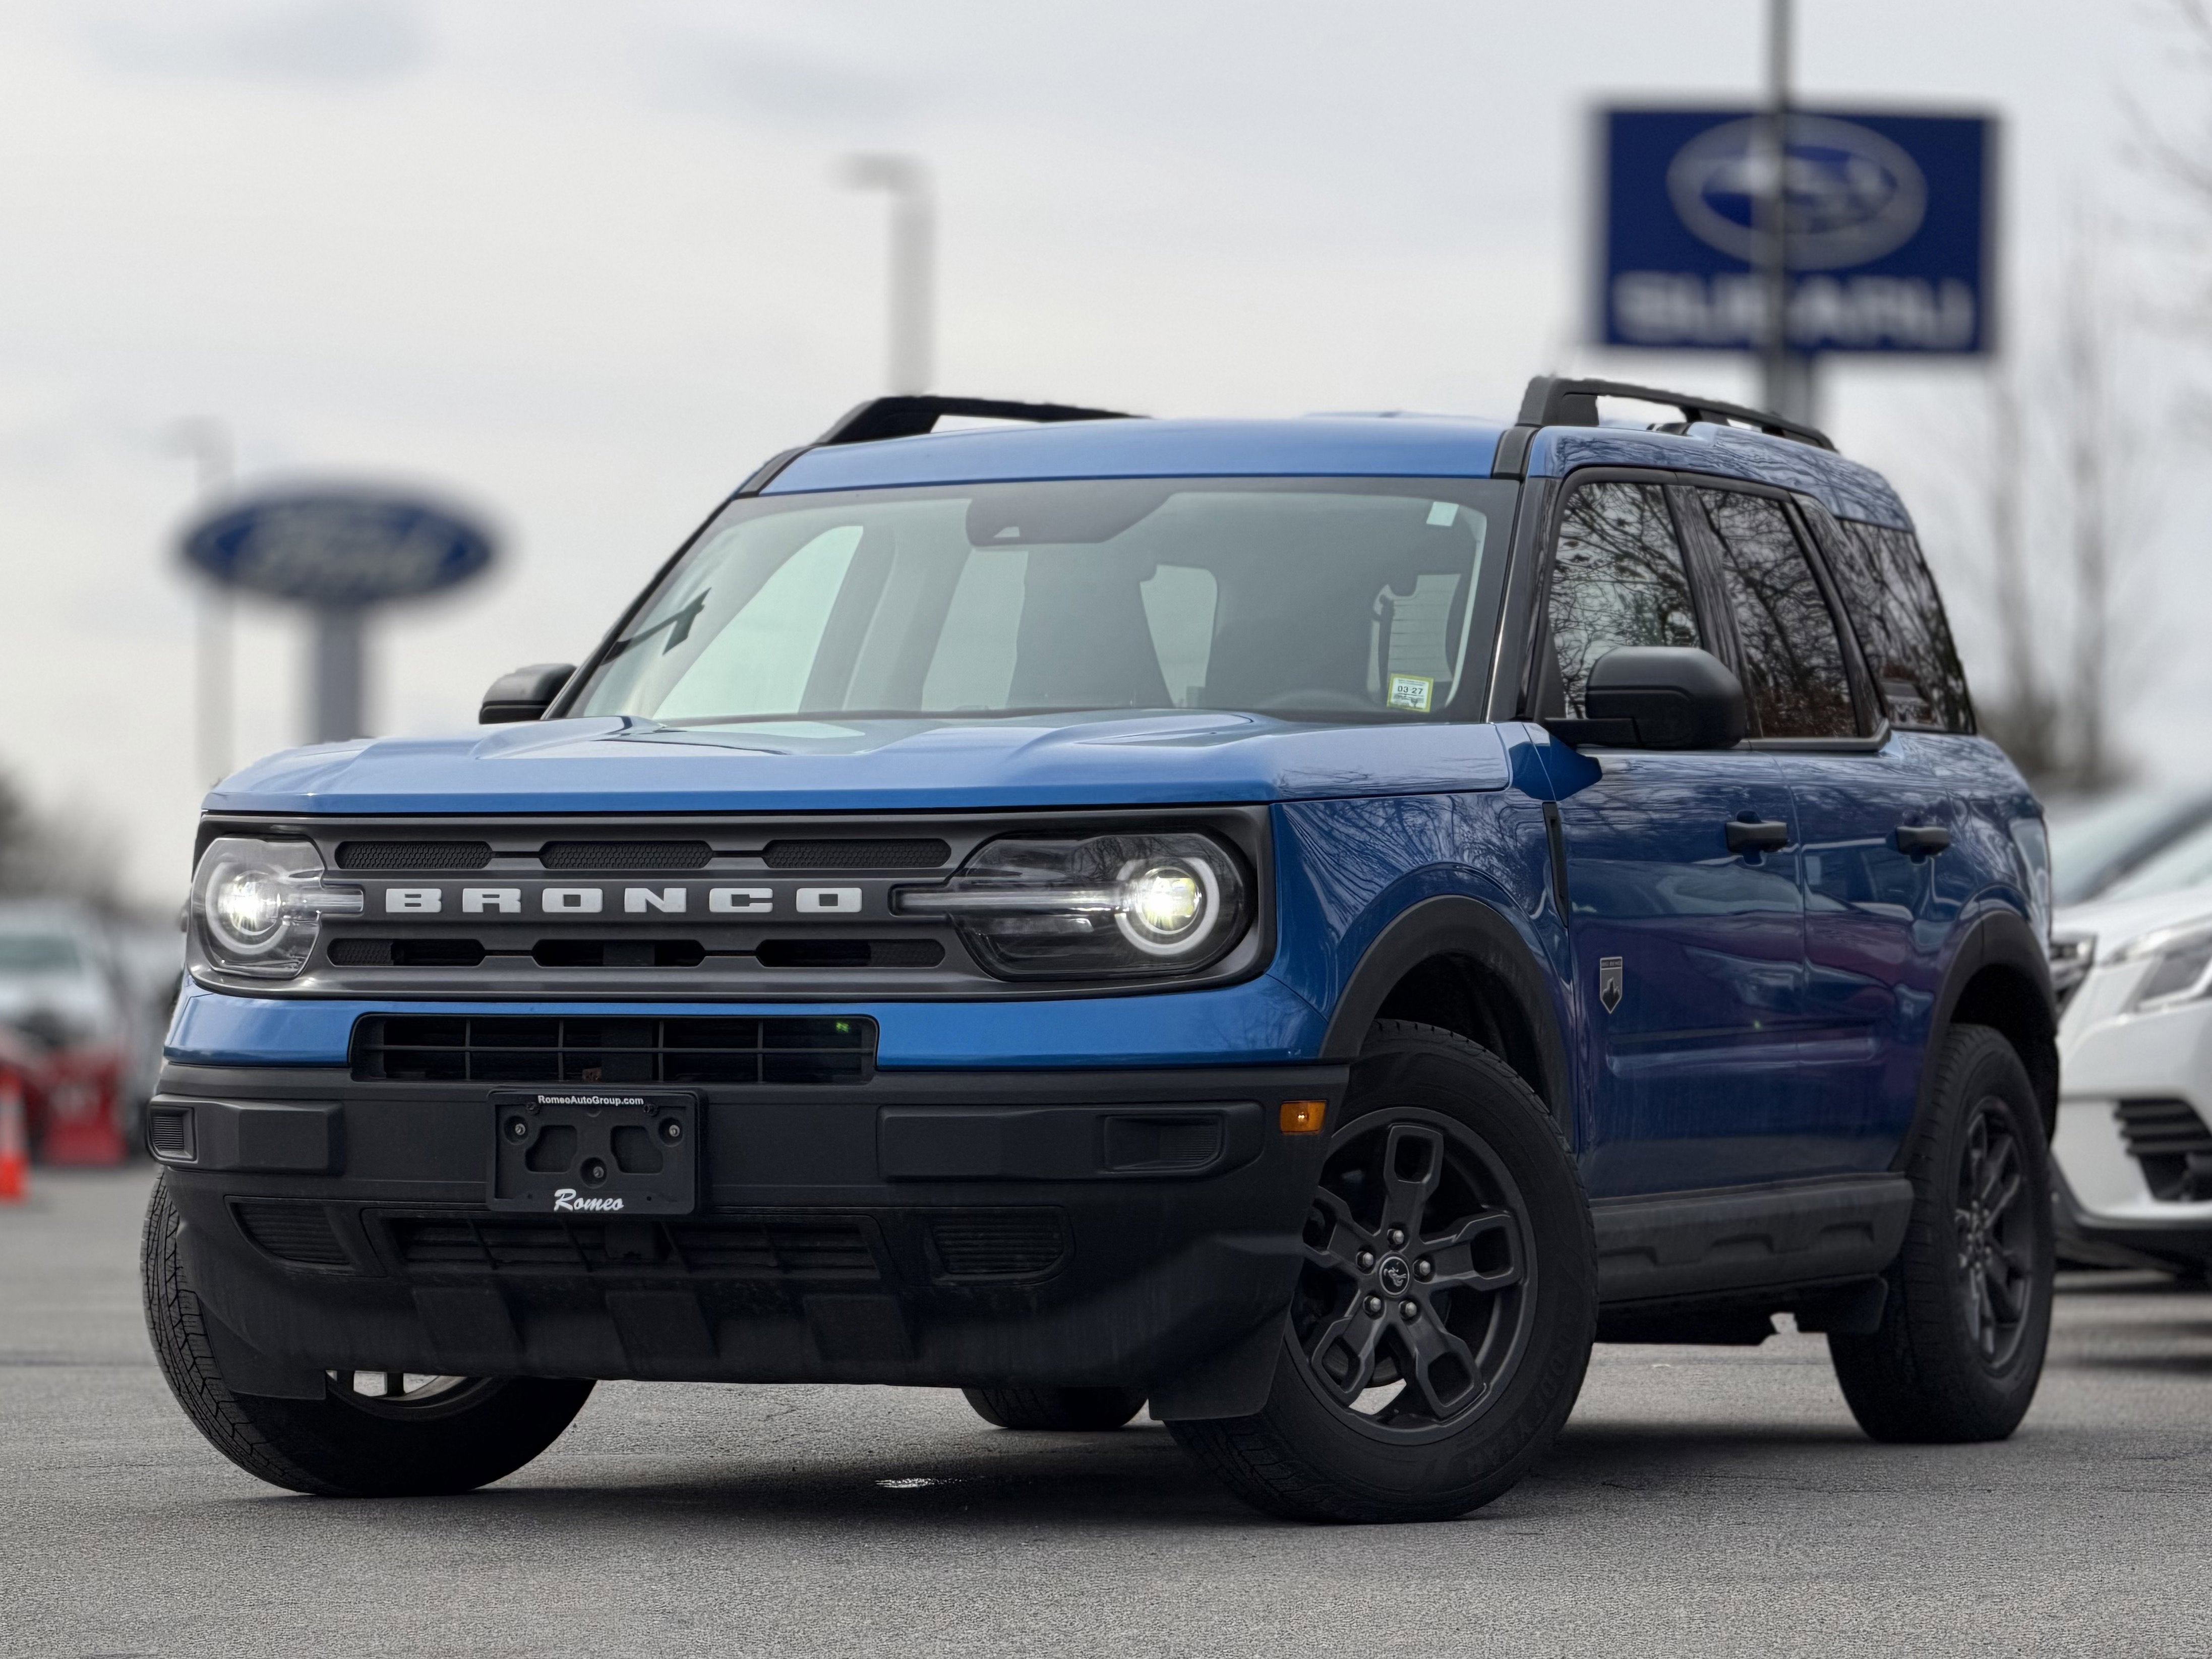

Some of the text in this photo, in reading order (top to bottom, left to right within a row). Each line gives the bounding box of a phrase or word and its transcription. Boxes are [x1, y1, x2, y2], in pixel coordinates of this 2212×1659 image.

[1397, 685, 1409, 693] 03
[385, 887, 863, 913] BRONCO
[537, 1095, 644, 1106] RomeoAutoGroup.com
[554, 1188, 625, 1212] Romeo
